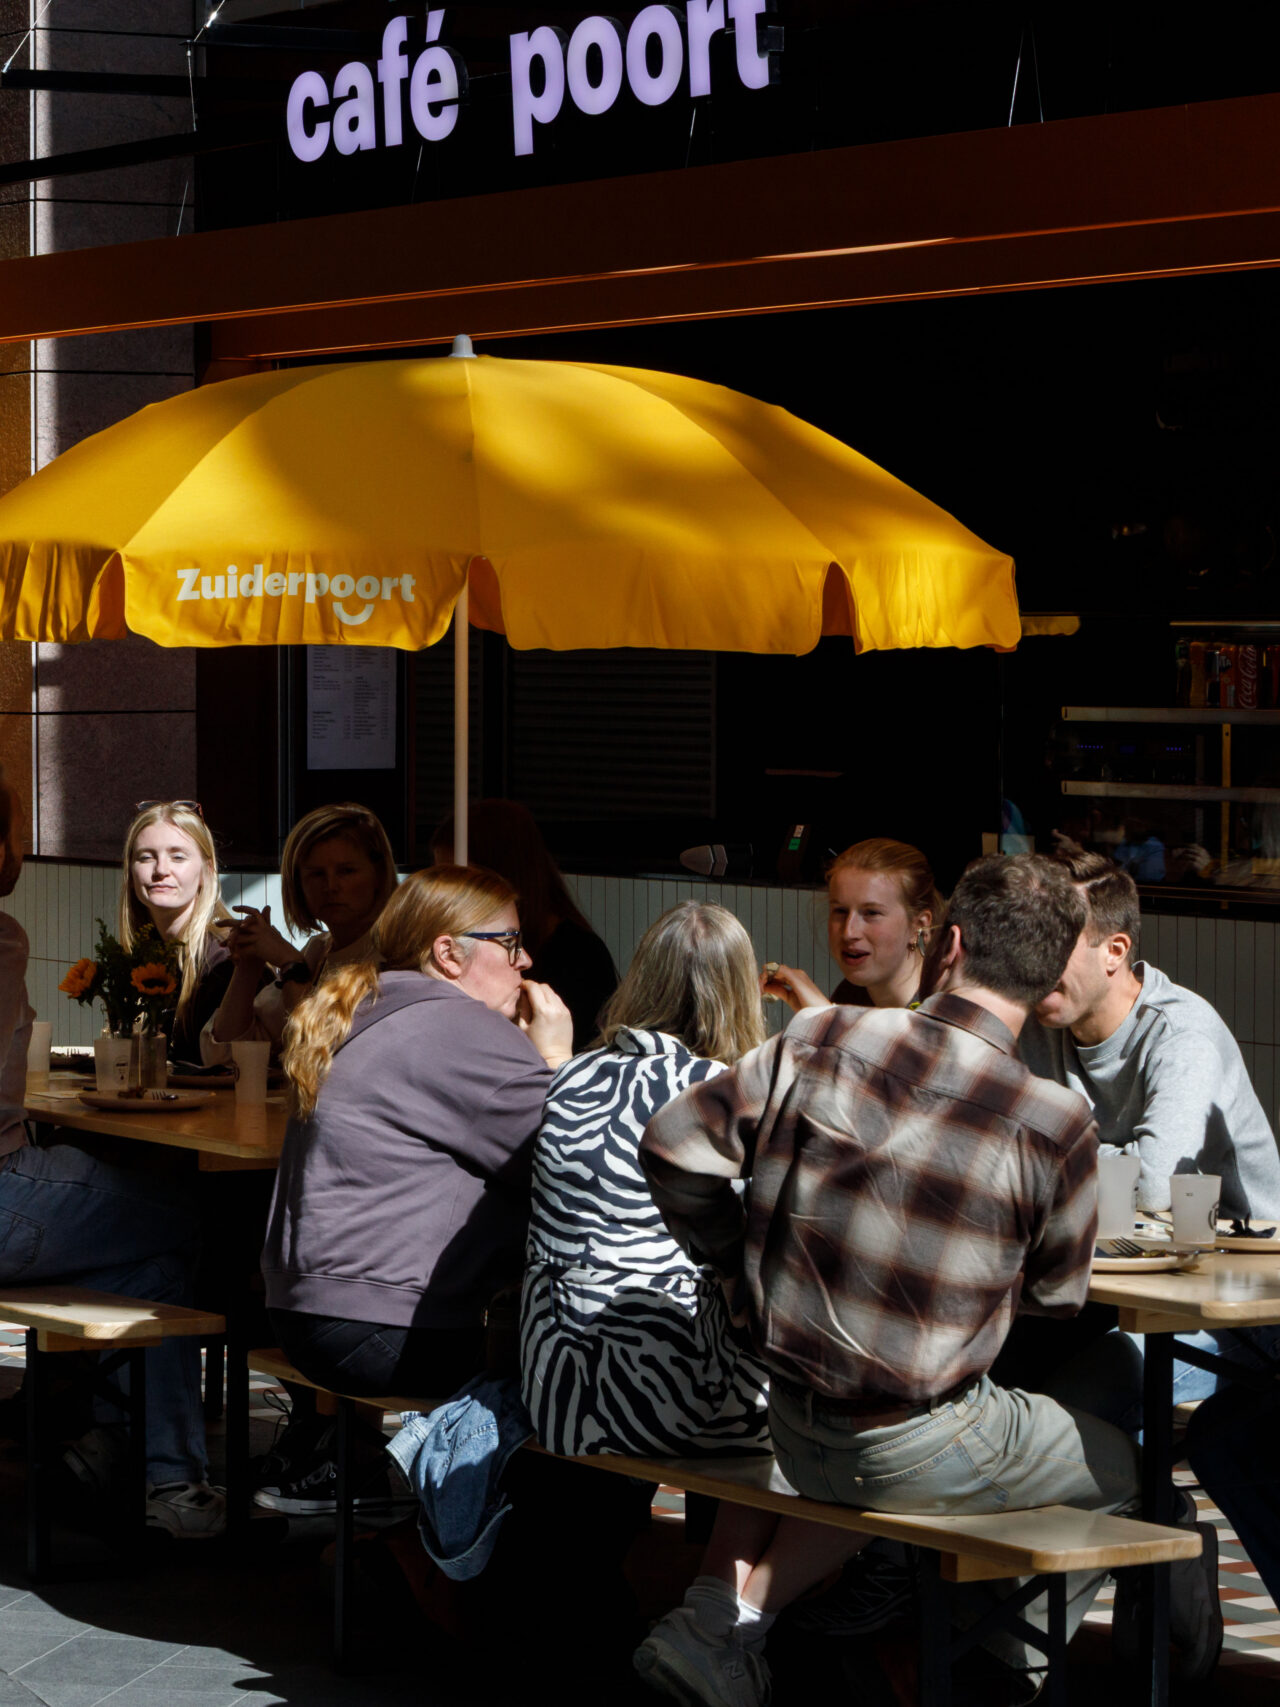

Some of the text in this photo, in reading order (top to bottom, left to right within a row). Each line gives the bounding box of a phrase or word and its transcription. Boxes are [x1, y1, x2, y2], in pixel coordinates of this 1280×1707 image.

[287, 0, 770, 162] café poort
[176, 564, 416, 604] Zuiderpoort
